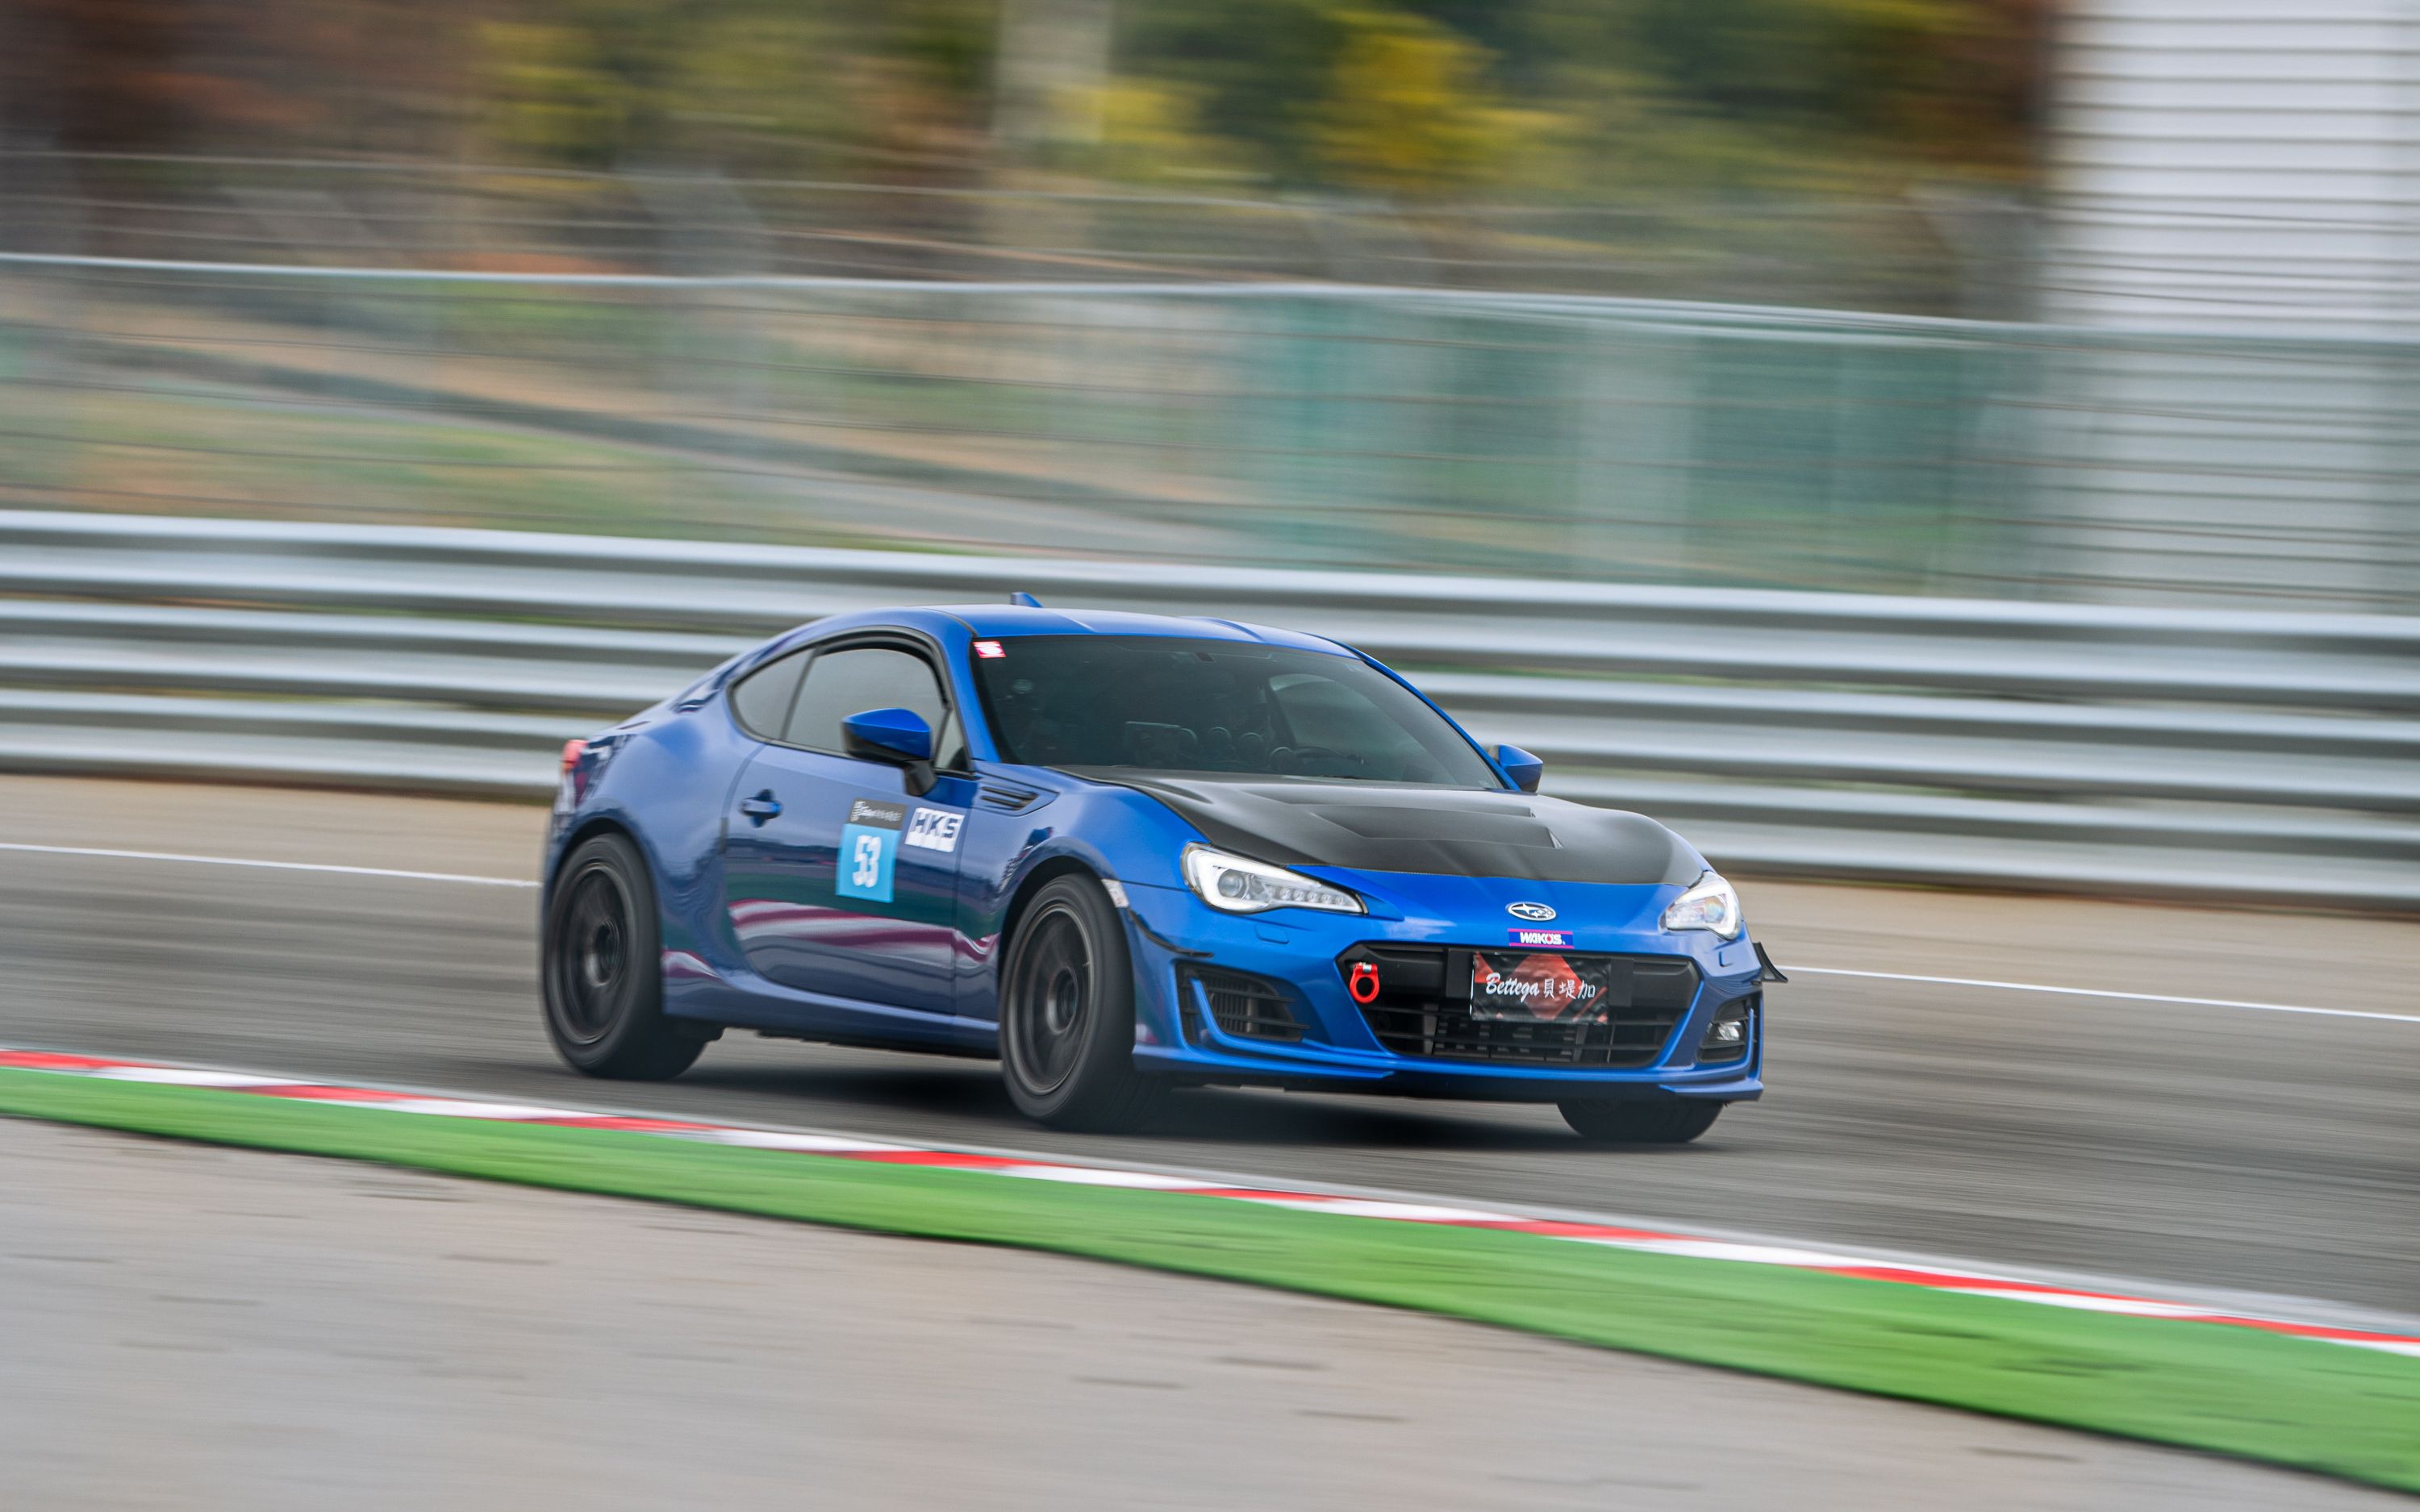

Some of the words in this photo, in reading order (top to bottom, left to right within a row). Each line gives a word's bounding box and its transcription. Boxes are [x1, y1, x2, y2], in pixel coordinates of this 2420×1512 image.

[910, 812, 958, 839] HKS
[853, 835, 882, 887] 53
[1486, 973, 1540, 1002] Bettega
